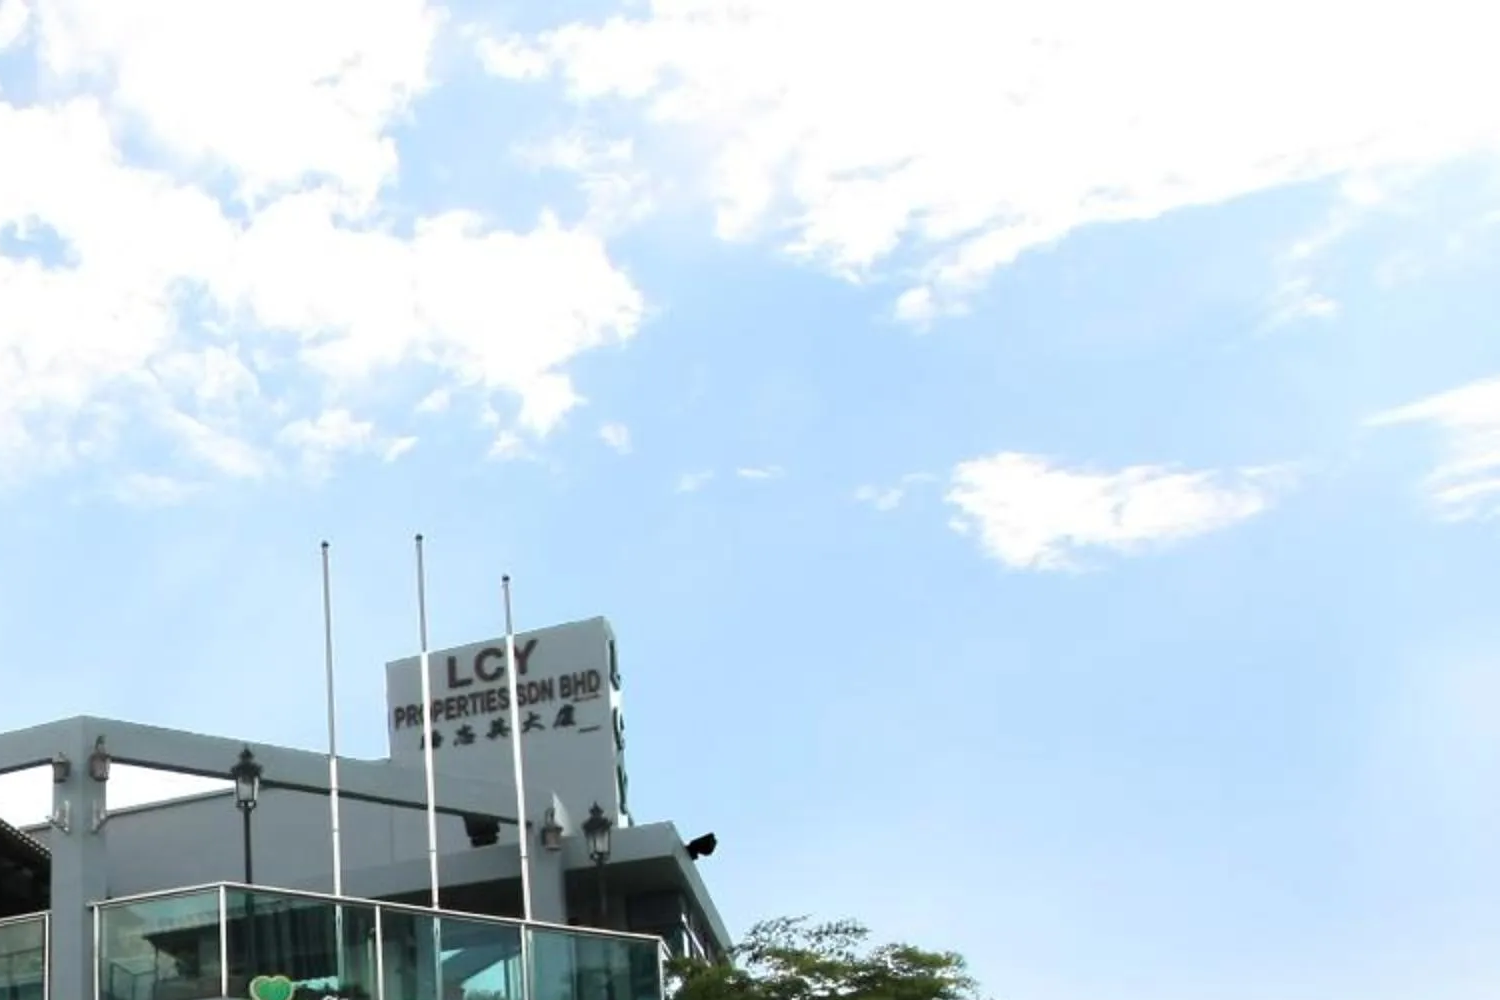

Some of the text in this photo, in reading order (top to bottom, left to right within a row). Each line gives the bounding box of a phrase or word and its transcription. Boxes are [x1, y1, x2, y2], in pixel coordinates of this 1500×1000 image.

[447, 639, 537, 689] LCY
[517, 678, 554, 706] SDN
[559, 669, 601, 698] BHD
